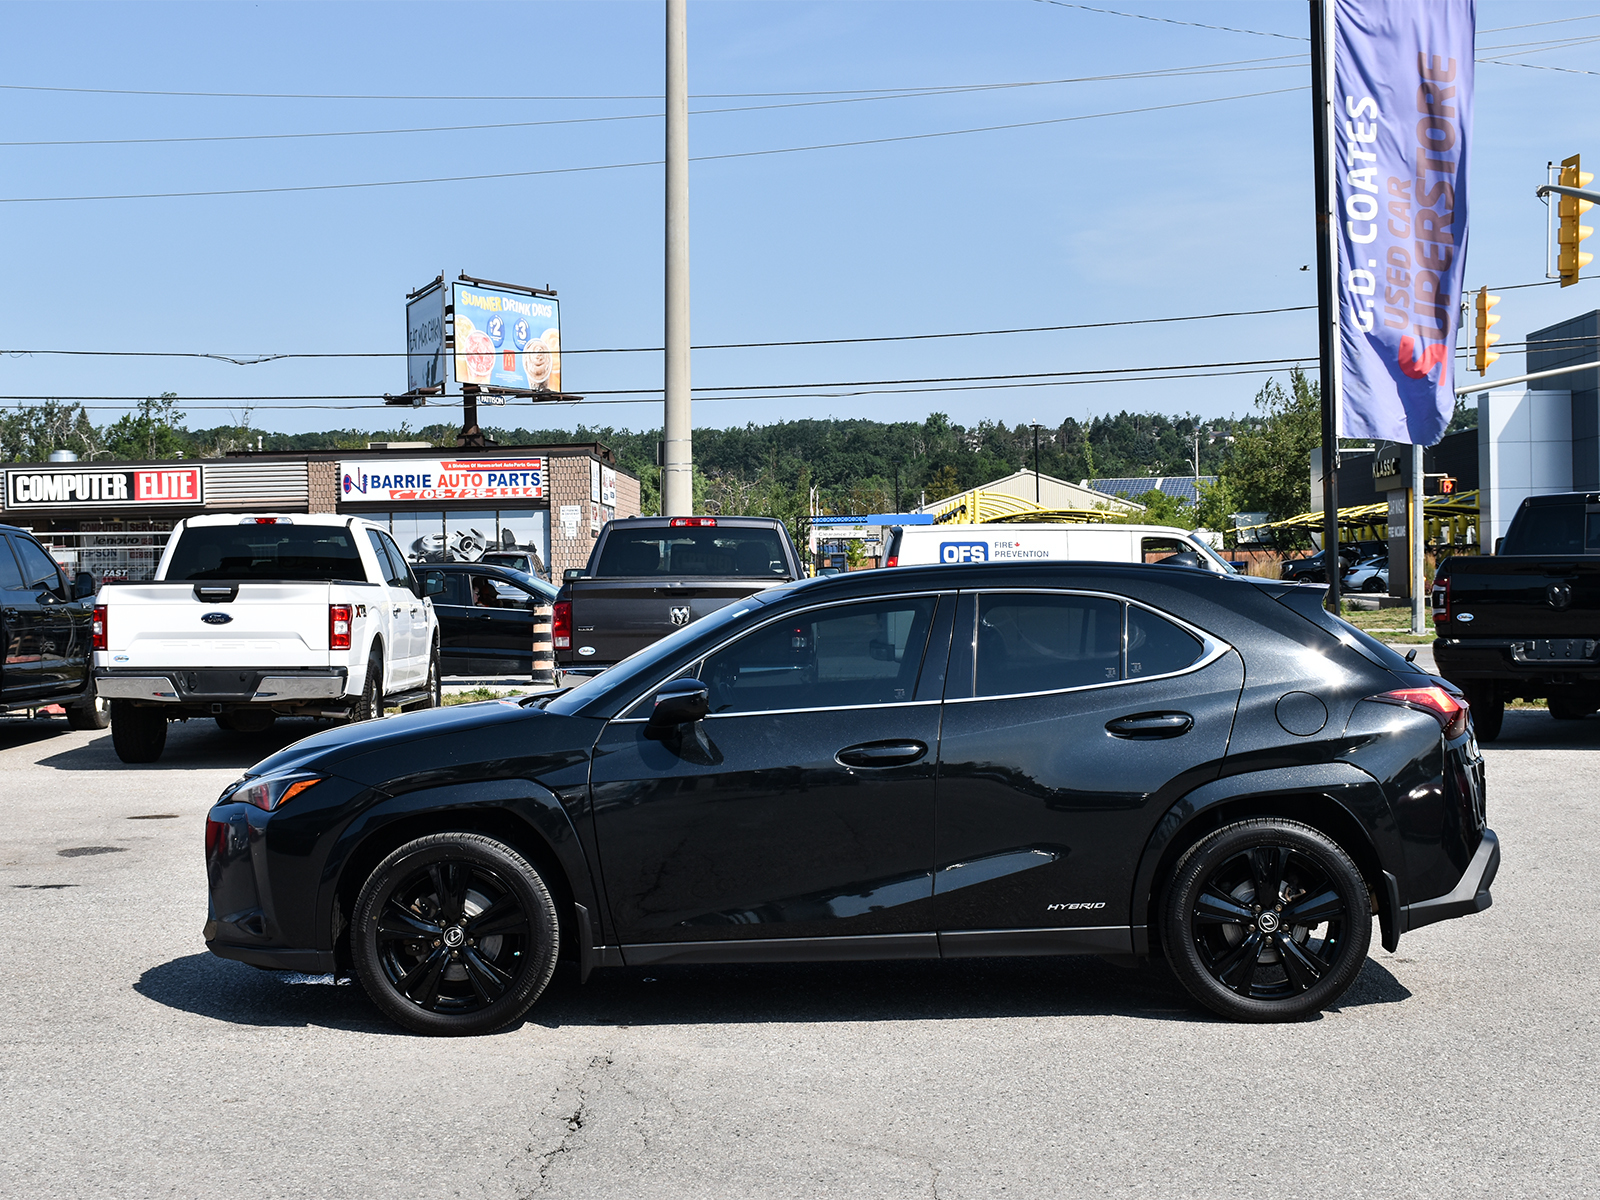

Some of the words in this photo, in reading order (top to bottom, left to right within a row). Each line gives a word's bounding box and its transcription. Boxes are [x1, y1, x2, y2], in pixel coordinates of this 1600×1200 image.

[1346, 95, 1378, 244] COATES
[1387, 176, 1412, 239] CAR
[1398, 51, 1456, 386] SUPERSTORE
[1348, 259, 1376, 333] G.D.
[1384, 246, 1411, 330] USED
[461, 291, 503, 312] SUMMER
[502, 297, 531, 317] DRINK
[531, 303, 553, 318] DAYS
[15, 473, 129, 502] COMPUTER
[139, 471, 193, 499] ELITE
[370, 474, 432, 489] BARRIE
[437, 473, 483, 488] AUTO
[487, 472, 541, 487] PARTS
[80, 522, 123, 533] COMPUTER
[129, 522, 170, 532] SERVICE
[943, 545, 985, 563] OFS
[994, 541, 1013, 549] FIRE
[994, 550, 1050, 558] PREVENTION
[103, 569, 128, 577] FAST
[1047, 902, 1106, 911] HYBRID
